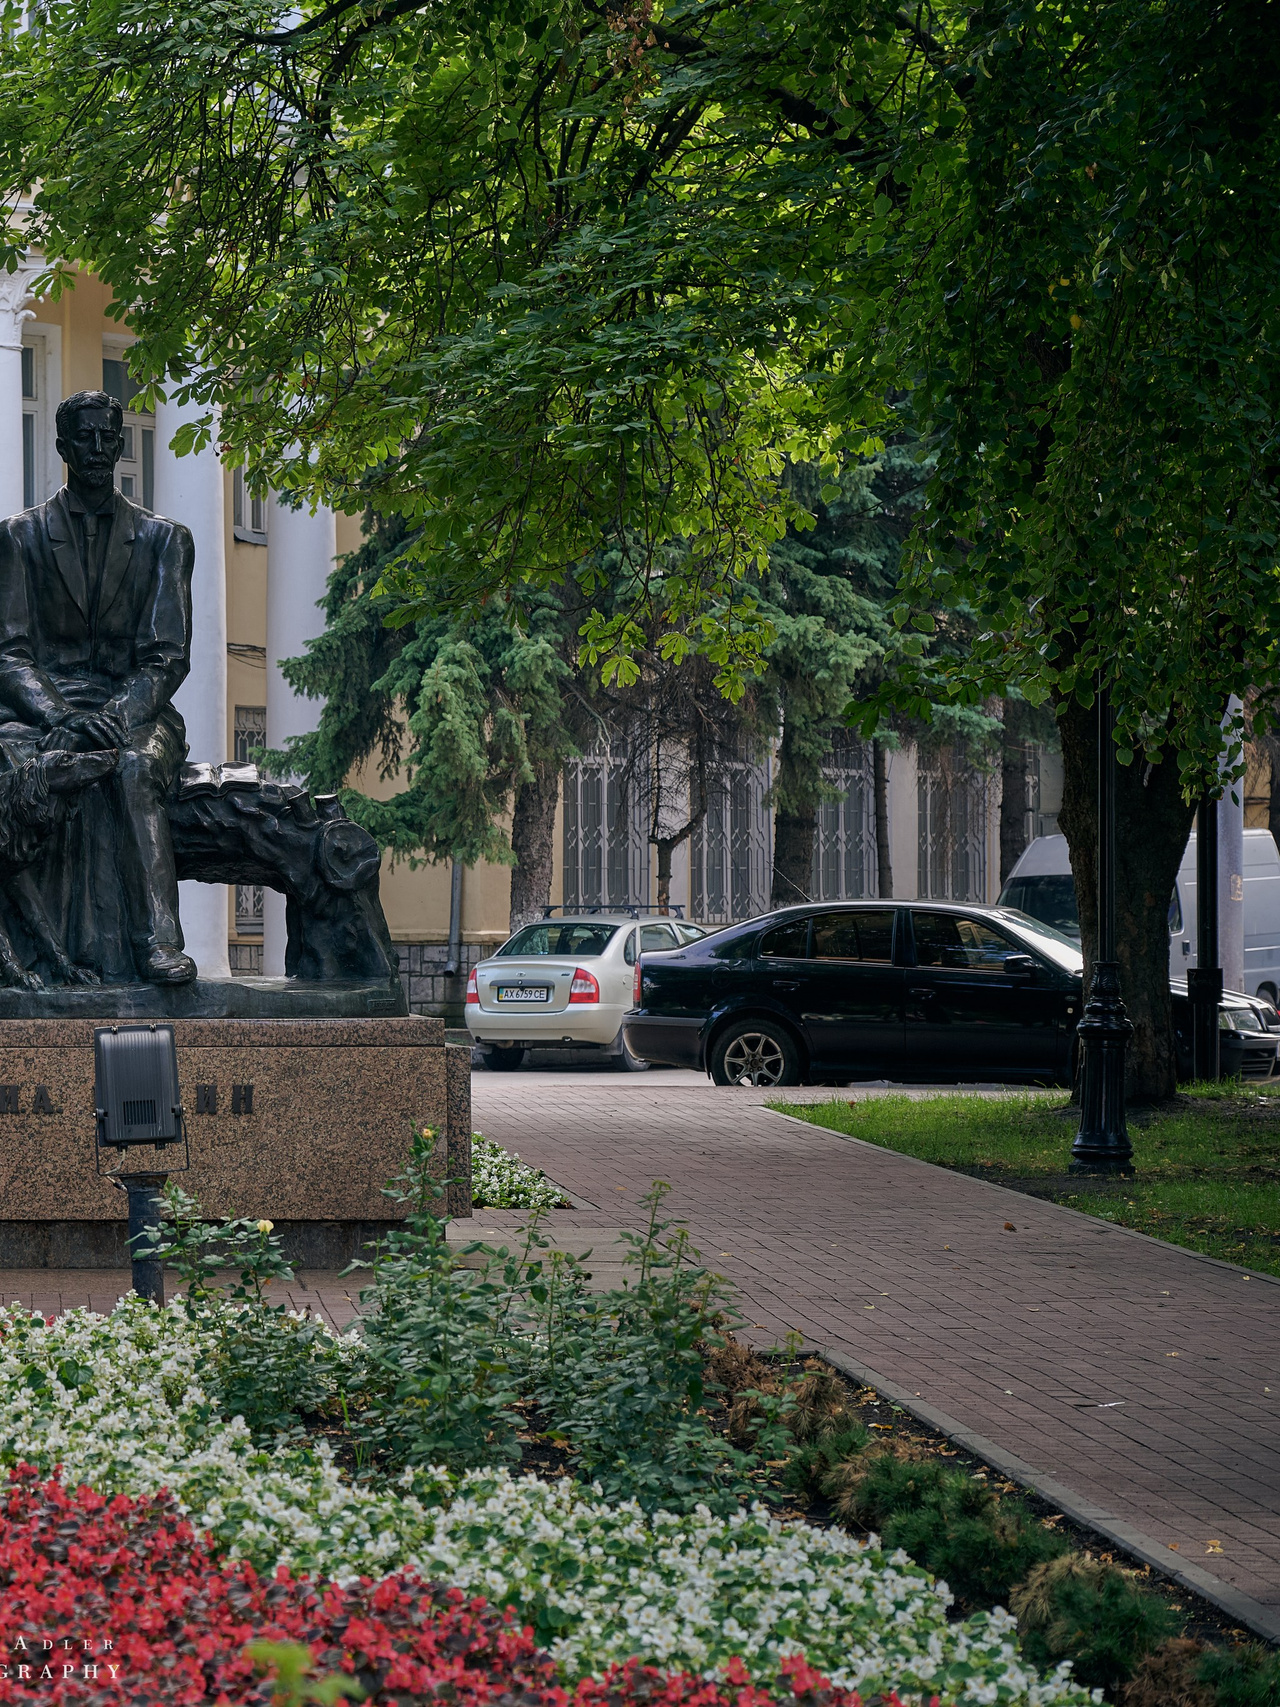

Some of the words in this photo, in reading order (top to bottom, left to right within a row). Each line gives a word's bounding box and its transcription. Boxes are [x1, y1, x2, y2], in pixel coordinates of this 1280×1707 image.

[504, 990, 514, 998] AX
[515, 990, 532, 998] 6759
[533, 990, 545, 998] CE
